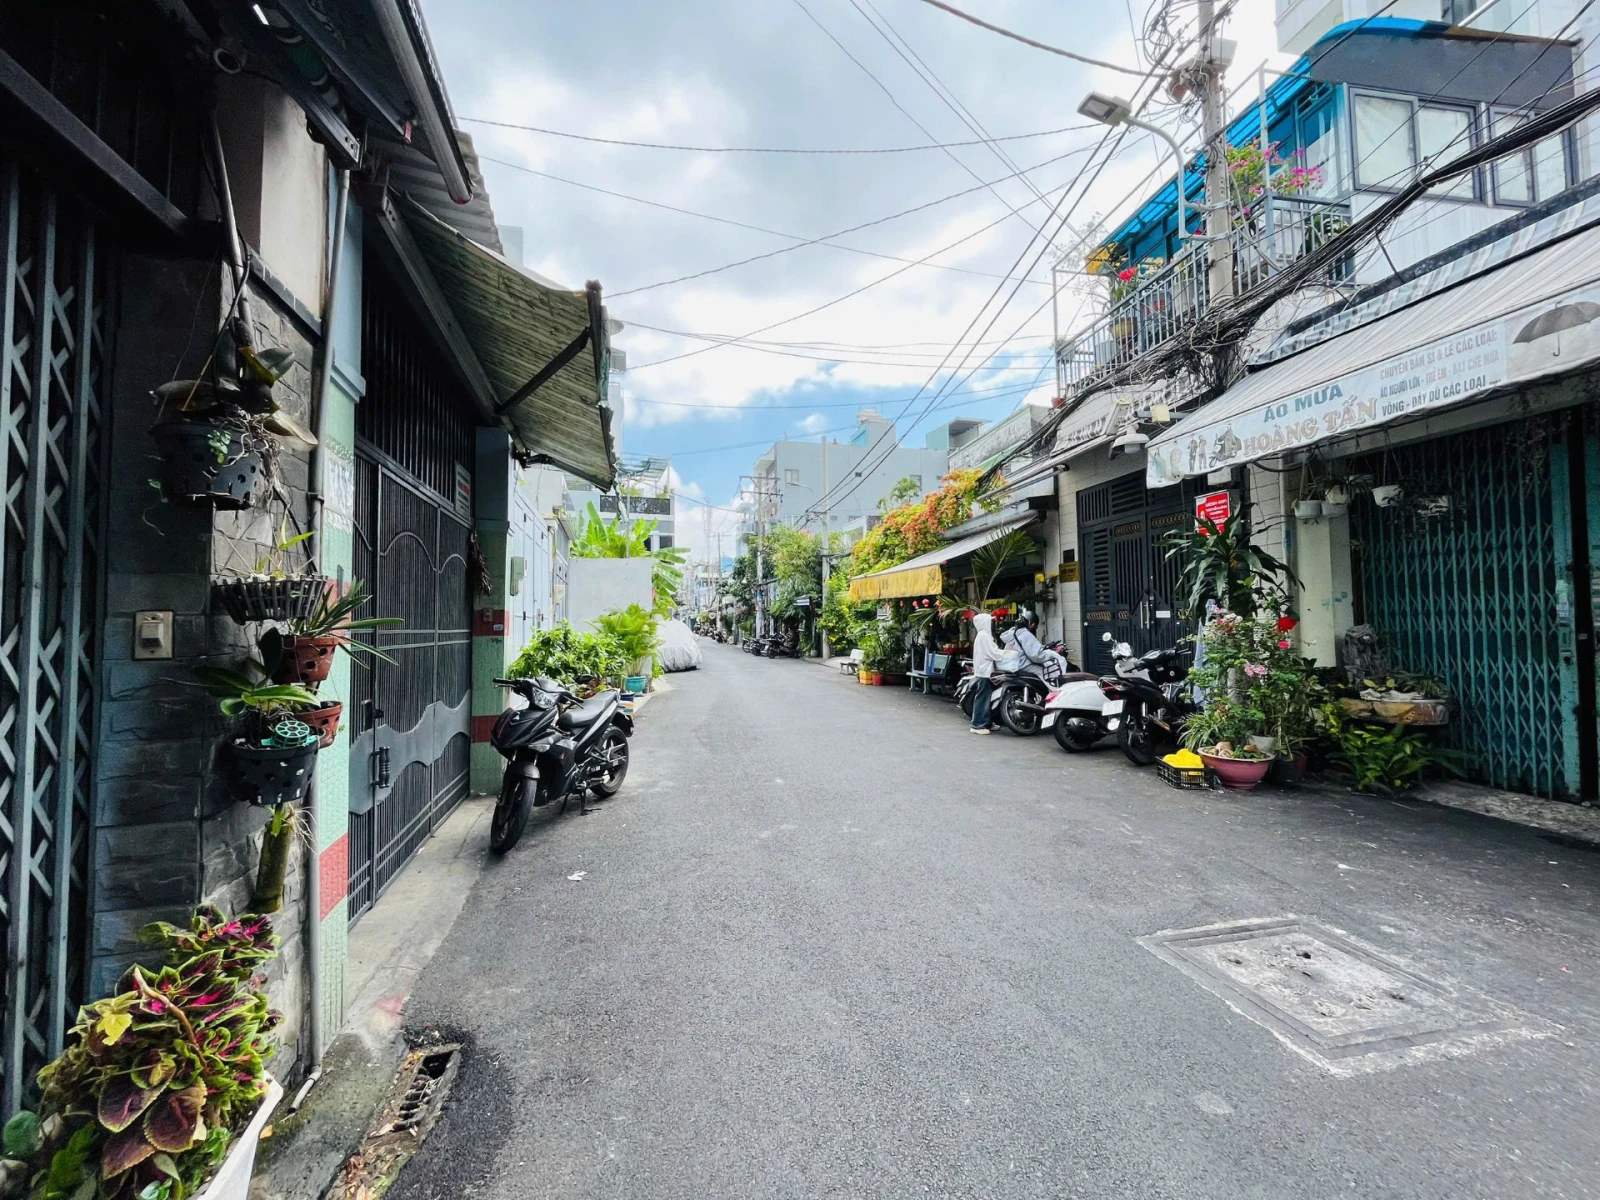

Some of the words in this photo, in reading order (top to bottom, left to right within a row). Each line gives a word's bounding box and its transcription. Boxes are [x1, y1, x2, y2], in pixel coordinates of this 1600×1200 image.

[1380, 361, 1408, 380] CHUYÊN
[1410, 355, 1425, 370] BÁN
[1436, 349, 1443, 361] &
[1455, 337, 1473, 354] CÁC
[1437, 366, 1447, 382] EM
[1467, 356, 1482, 371] CHE
[1263, 403, 1288, 423] ÁO
[1294, 384, 1343, 412] MƯA
[1382, 398, 1404, 417] VÕNG
[1443, 380, 1461, 398] CÁC
[1463, 374, 1486, 393] LOẠI
[1243, 416, 1319, 456] HOÀNG
[1323, 394, 1378, 433] TẤN
